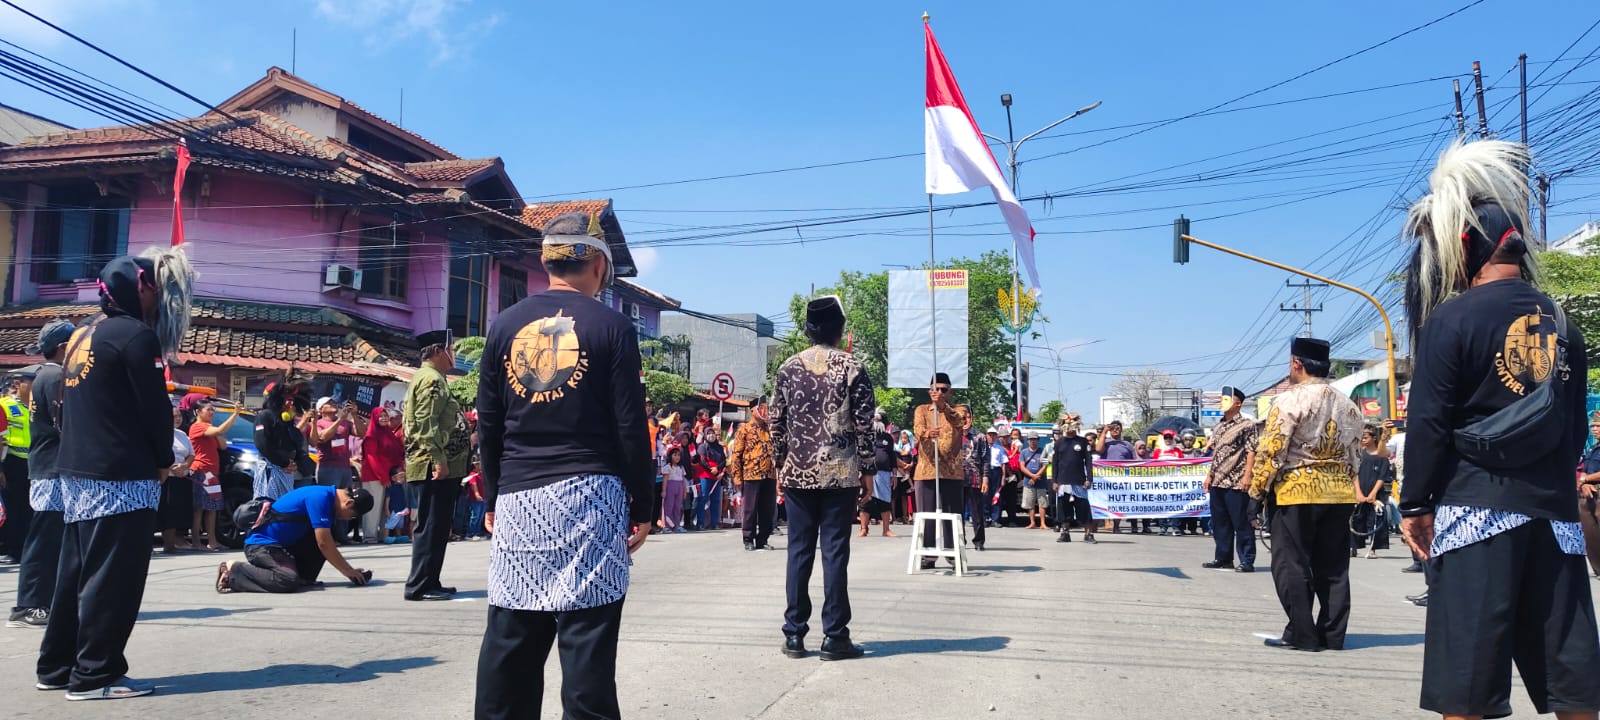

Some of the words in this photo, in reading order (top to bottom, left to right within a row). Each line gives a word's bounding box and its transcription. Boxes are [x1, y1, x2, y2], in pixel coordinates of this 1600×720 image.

[567, 358, 589, 389] KOTA
[1495, 358, 1525, 396] ONTHEL
[1130, 466, 1178, 477] BERHENTI
[1092, 481, 1131, 491] ERINGATI
[1134, 481, 1189, 490] DETIK-DETIK
[1192, 480, 1203, 490] PR
[1108, 494, 1127, 502] HUT
[1130, 494, 1139, 502] RI
[1142, 493, 1167, 502] KE-80
